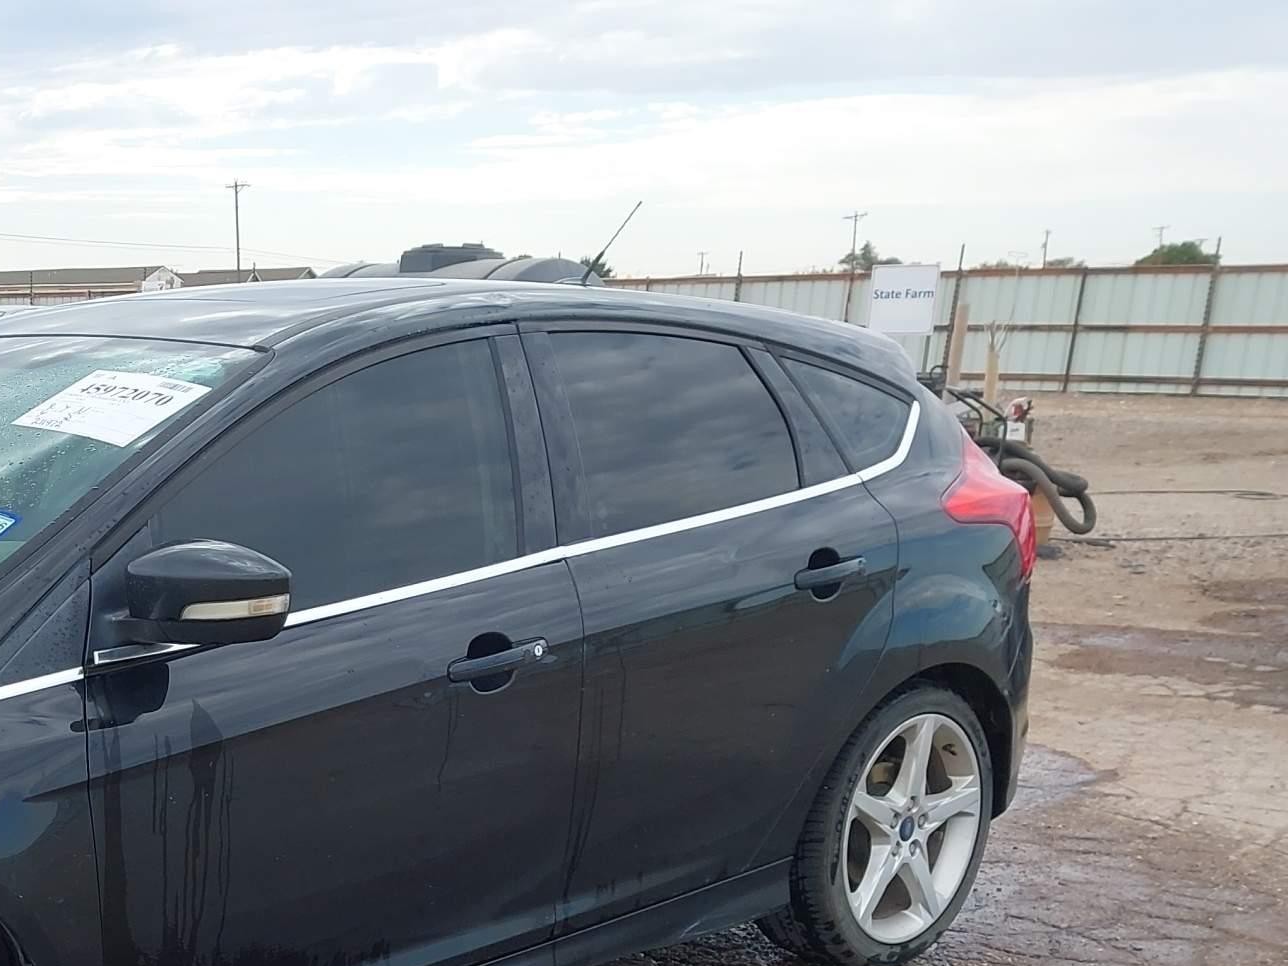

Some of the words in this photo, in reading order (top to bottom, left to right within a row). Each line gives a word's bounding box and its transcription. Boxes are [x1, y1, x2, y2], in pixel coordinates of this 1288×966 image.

[873, 288, 902, 300] State
[905, 288, 935, 299] Farm
[79, 383, 175, 407] 45972070
